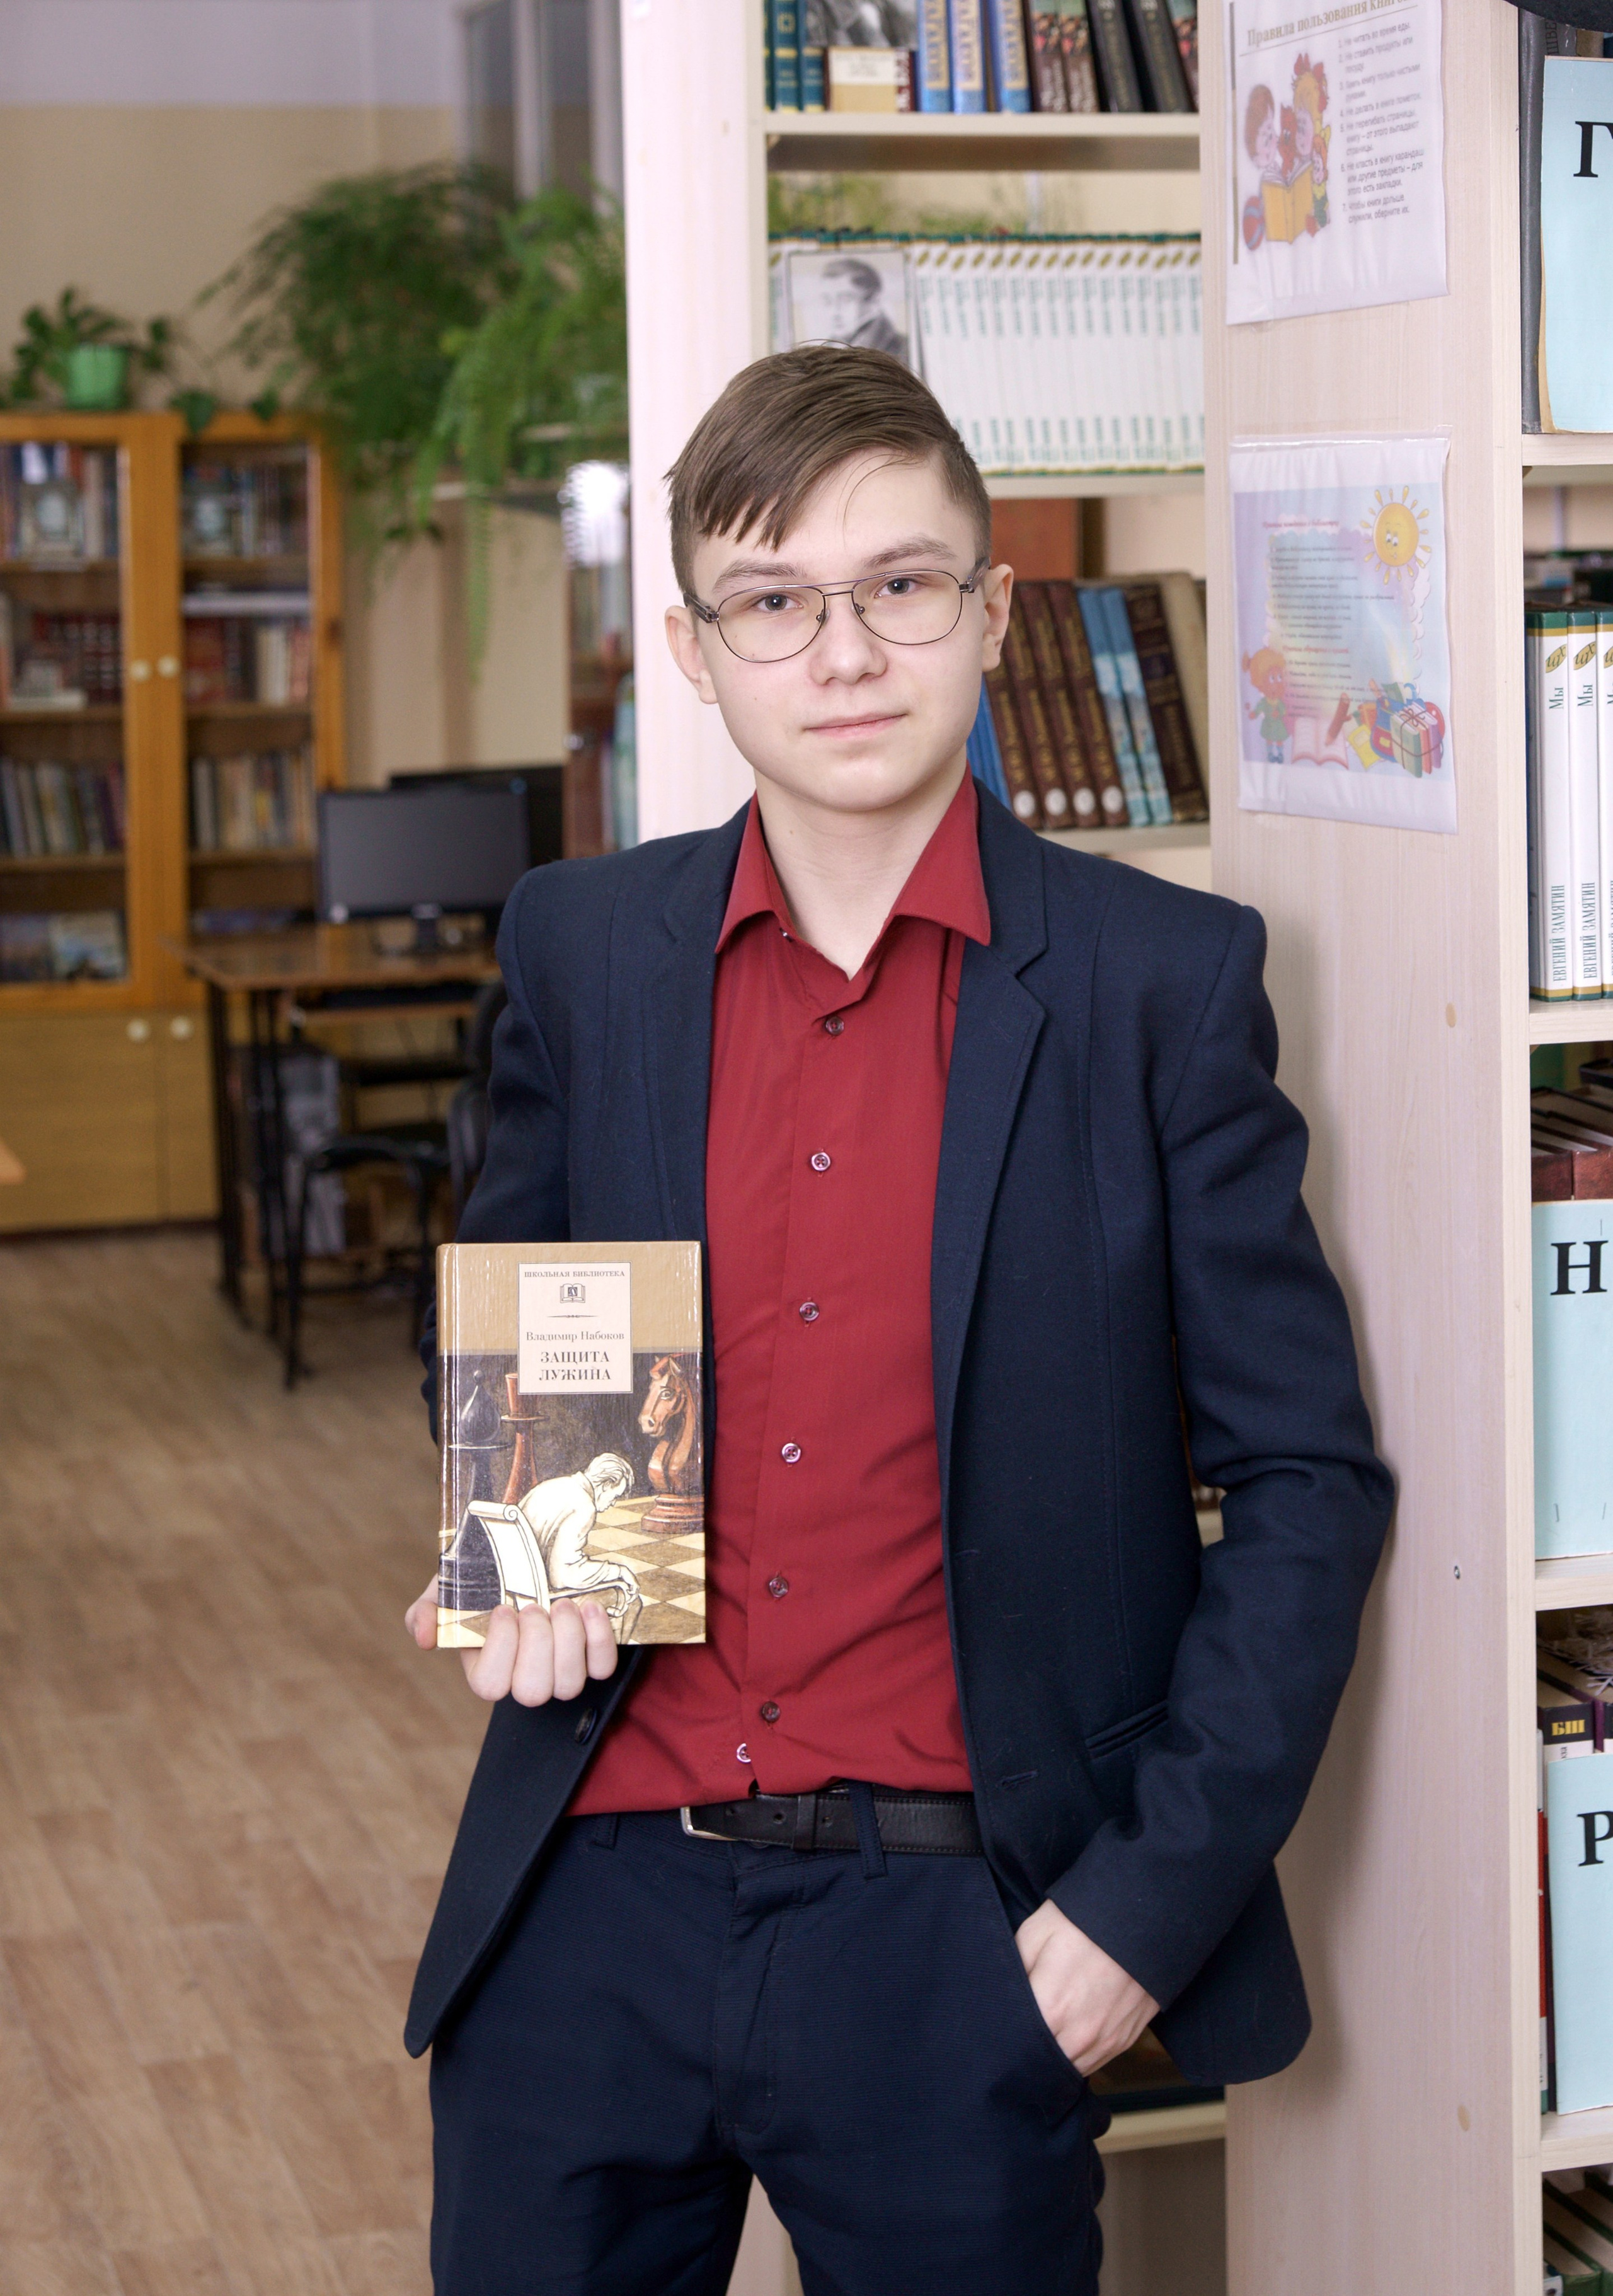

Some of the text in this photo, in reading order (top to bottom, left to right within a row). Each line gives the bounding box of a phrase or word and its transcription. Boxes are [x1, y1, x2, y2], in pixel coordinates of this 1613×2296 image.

[1248, 24, 1295, 48] Правила
[1297, 1, 1367, 32] пользования
[1573, 121, 1613, 177] Г
[1549, 687, 1564, 709] Мы
[1577, 684, 1593, 707] Мы
[1549, 885, 1566, 981] ЕВГЕНИЙ ЗАМЯТИН
[1580, 882, 1597, 978] ЕВГЕНИЙ ЗАМЯТИН
[1550, 1240, 1609, 1296] Н
[526, 1330, 624, 1342] Владимир Набоков
[540, 1351, 609, 1364] ЗАЩИТА
[539, 1368, 611, 1381] ЛУЖИНА
[1577, 1810, 1613, 1867] Р
